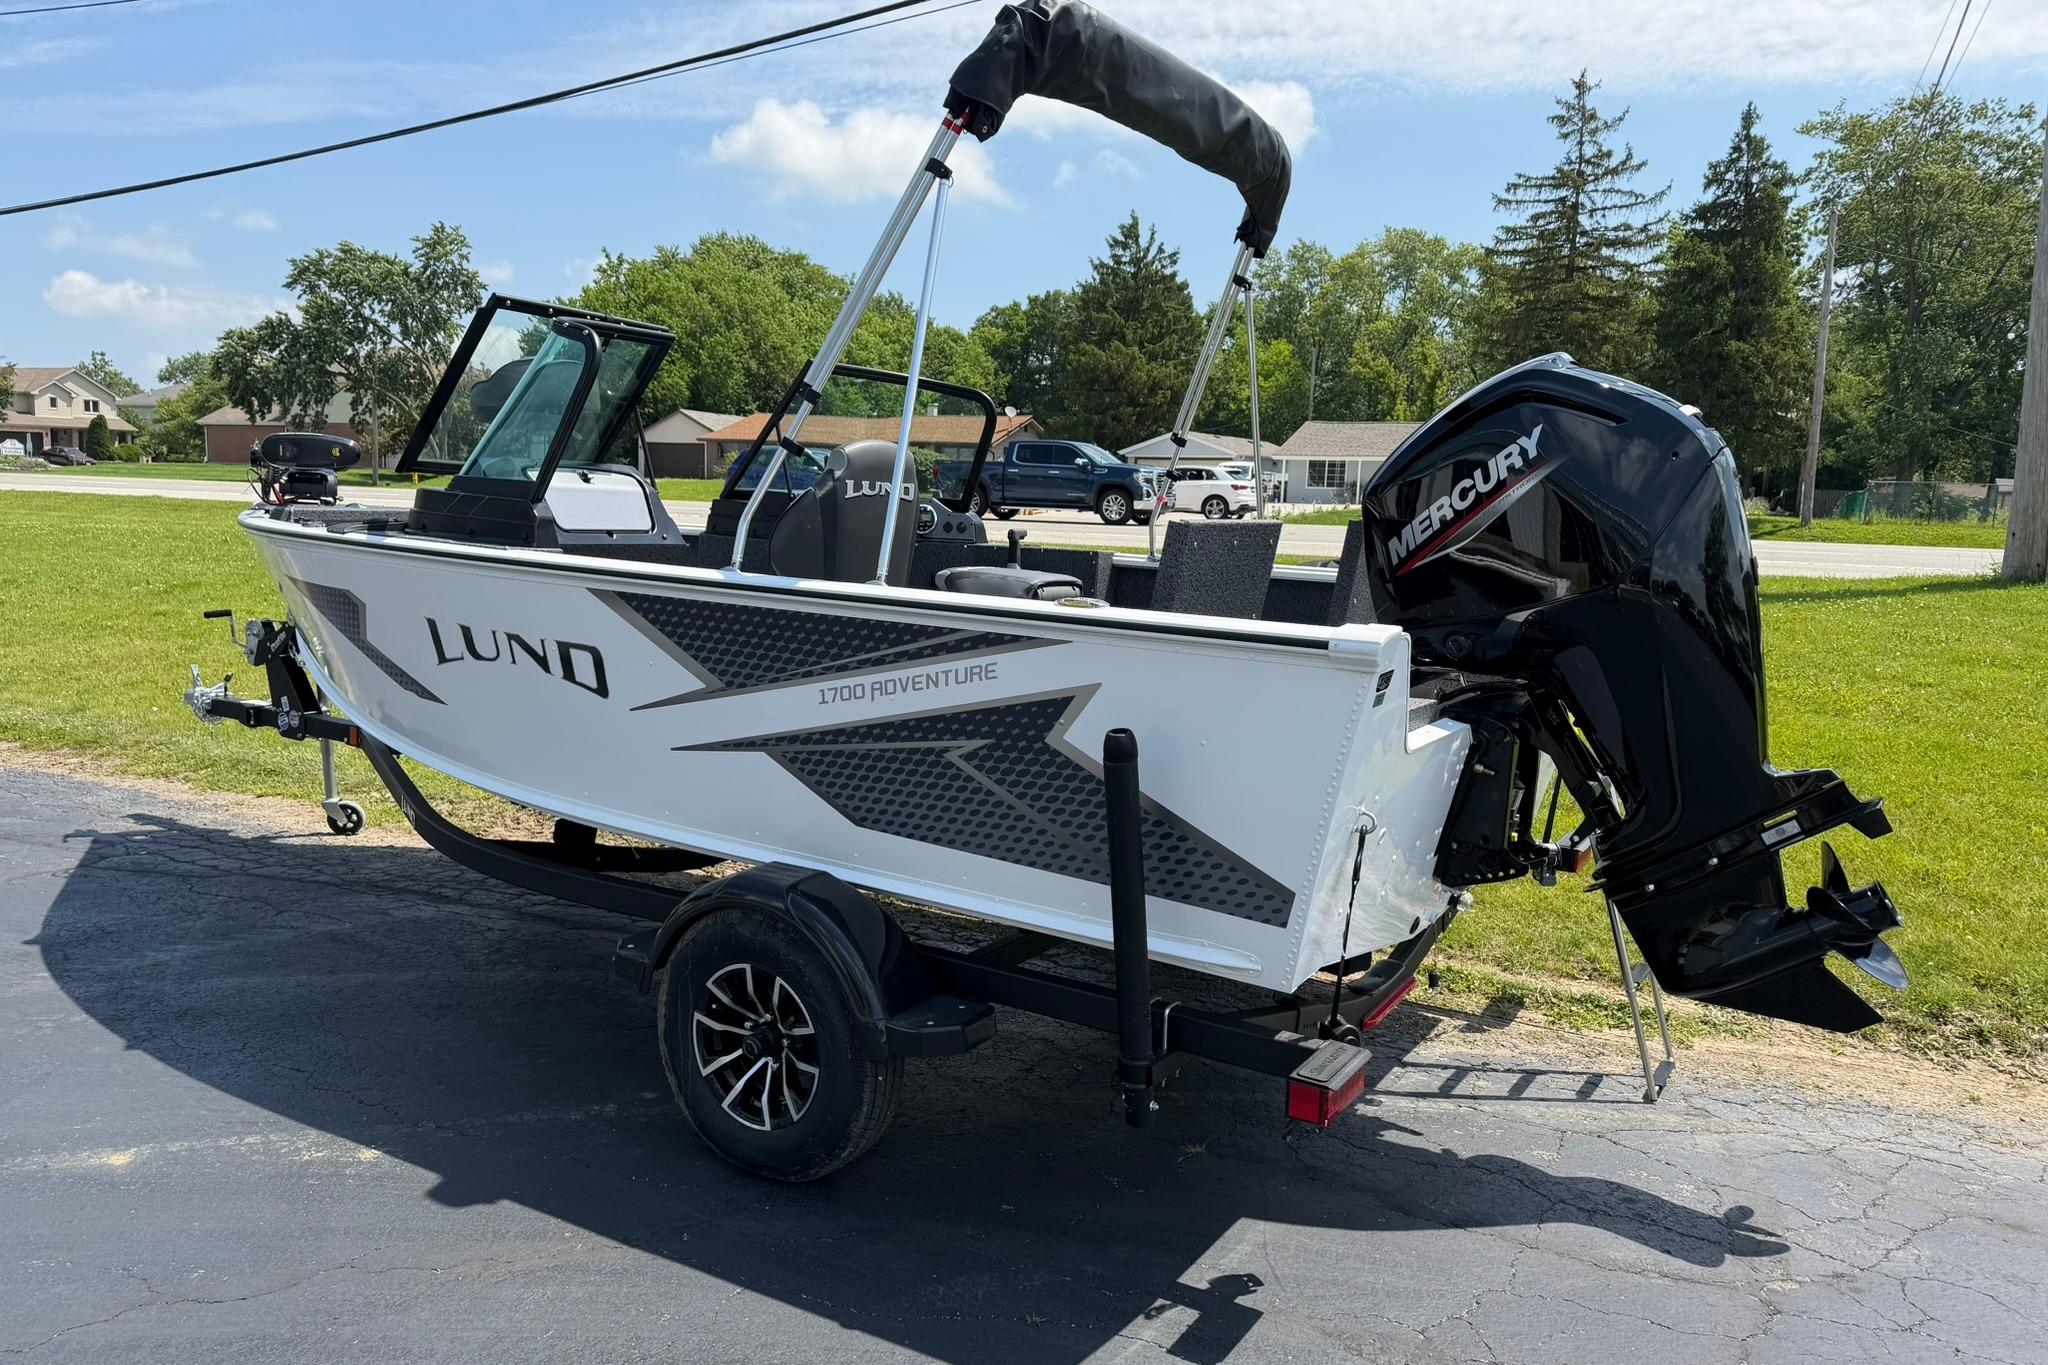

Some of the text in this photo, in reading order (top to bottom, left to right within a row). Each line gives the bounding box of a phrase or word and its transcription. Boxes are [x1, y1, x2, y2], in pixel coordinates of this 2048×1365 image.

[1388, 424, 1543, 566] MERCURY
[424, 616, 609, 699] LUND
[818, 662, 998, 705] 1700 ADVENTURE
